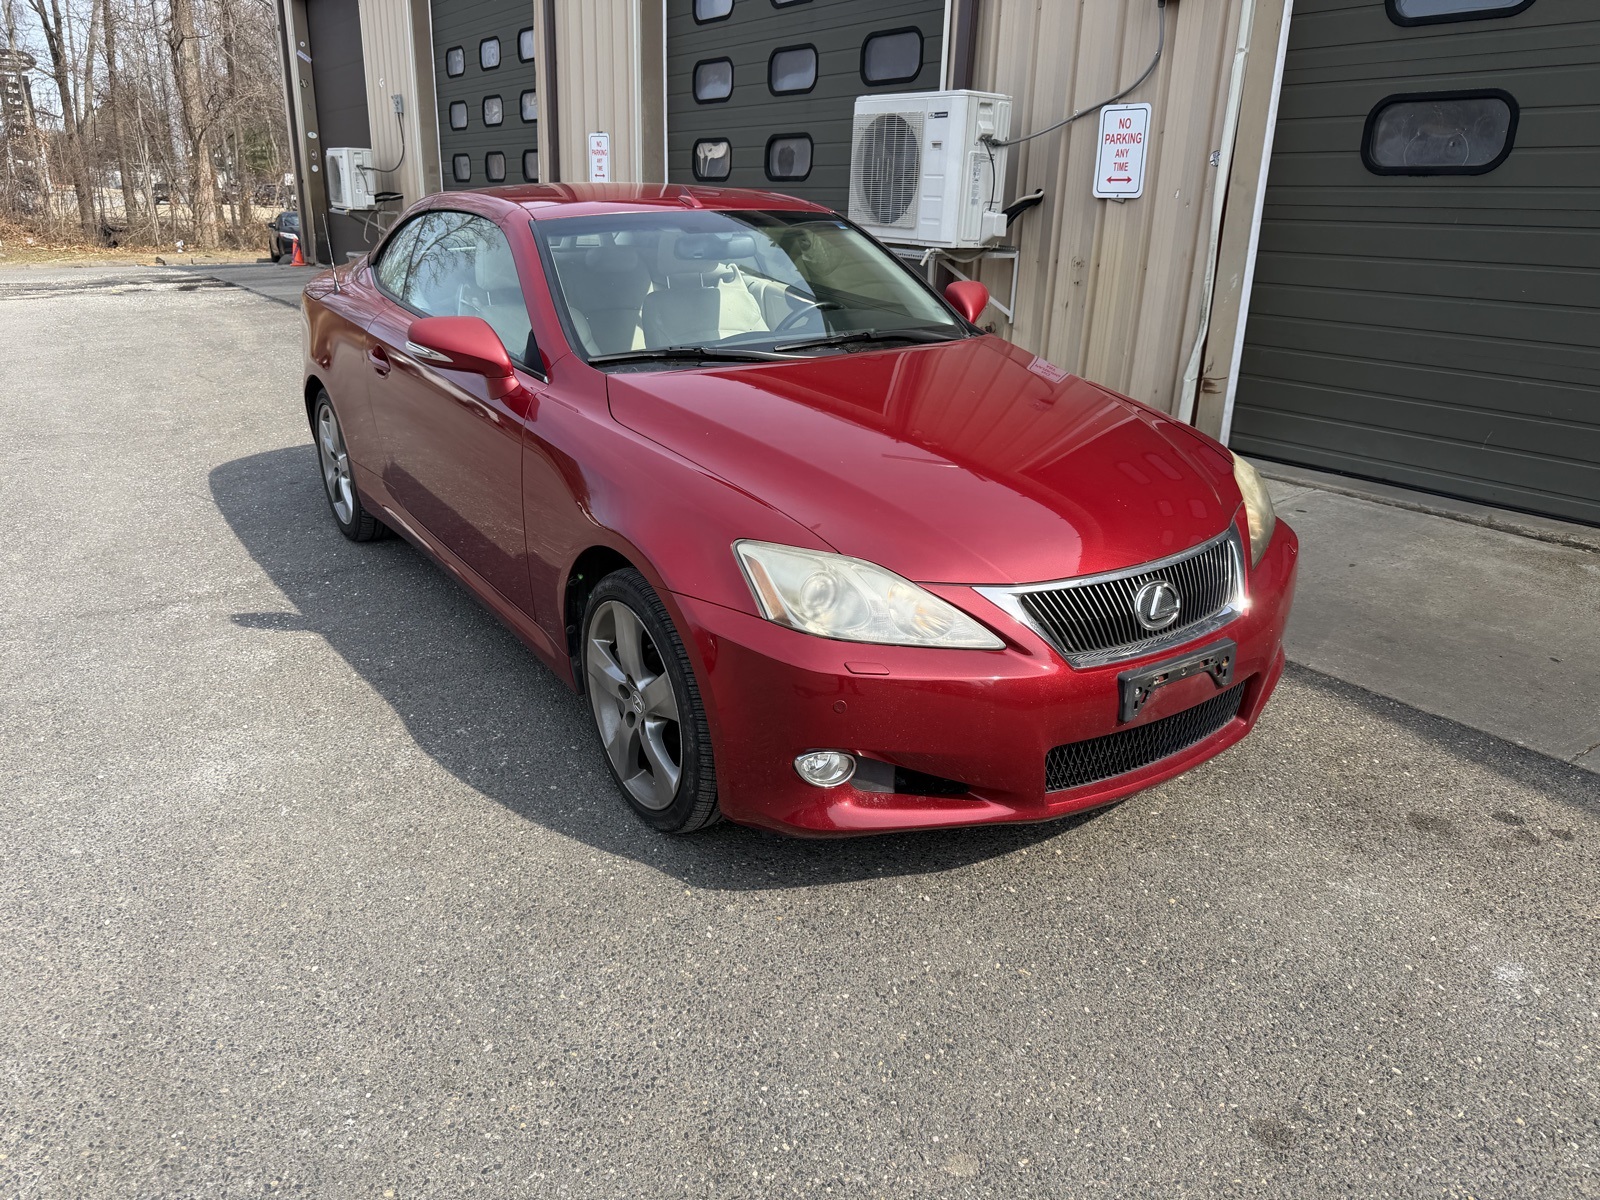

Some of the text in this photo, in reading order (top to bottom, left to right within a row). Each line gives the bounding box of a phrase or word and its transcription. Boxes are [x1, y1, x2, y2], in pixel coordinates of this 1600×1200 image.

[1118, 117, 1132, 129] NO
[1104, 132, 1142, 145] PARKING
[596, 140, 603, 148] NO
[1114, 148, 1130, 158] ANY
[1113, 161, 1129, 171] TIME
